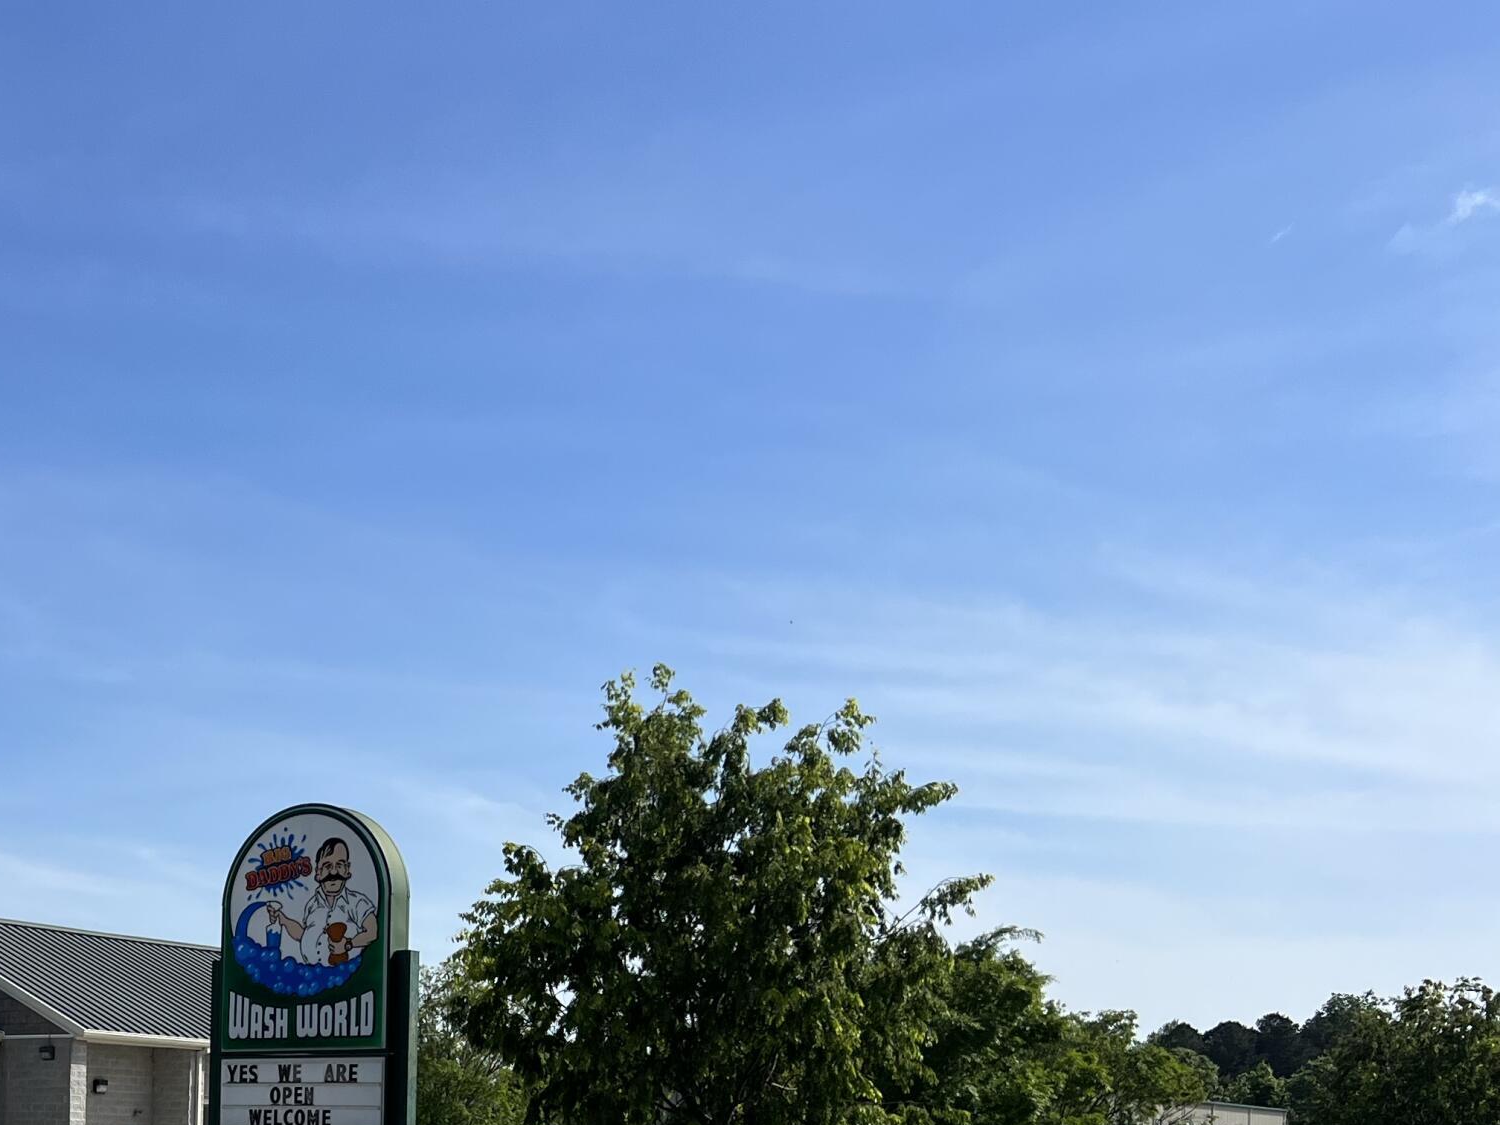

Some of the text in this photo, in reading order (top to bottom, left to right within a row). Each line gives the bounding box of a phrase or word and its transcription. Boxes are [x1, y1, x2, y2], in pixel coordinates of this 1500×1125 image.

[245, 856, 312, 891] DADDY'S
[228, 990, 374, 1039] WASH WORLD
[227, 1063, 358, 1084] YES WE ARE
[269, 1086, 314, 1106] OPEN
